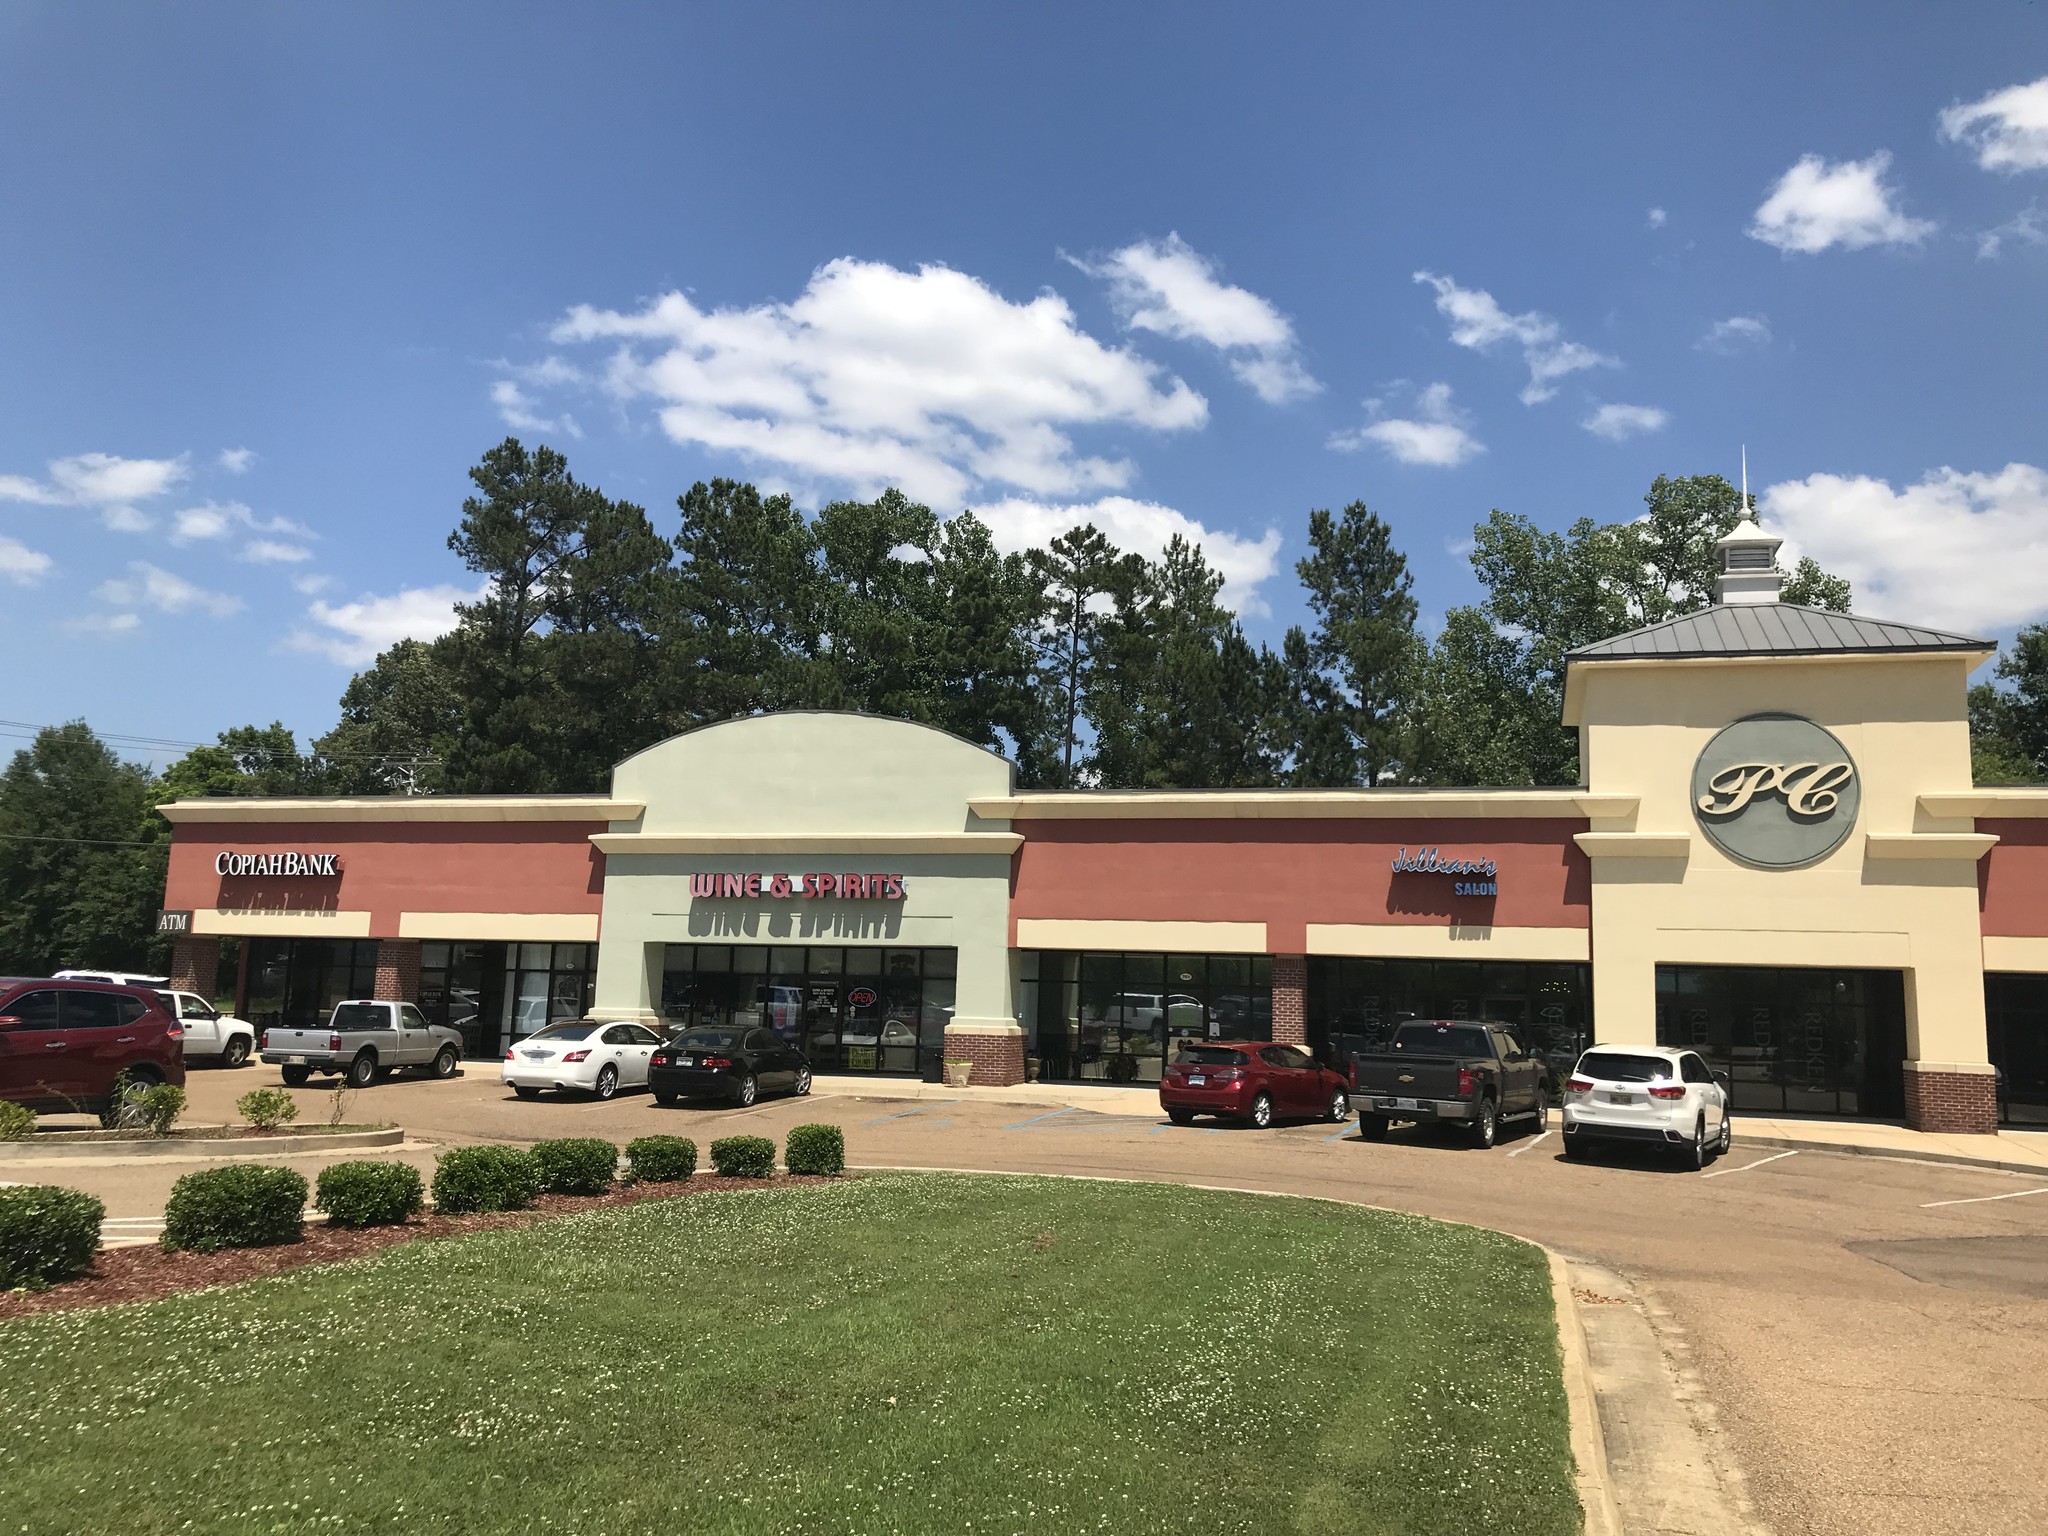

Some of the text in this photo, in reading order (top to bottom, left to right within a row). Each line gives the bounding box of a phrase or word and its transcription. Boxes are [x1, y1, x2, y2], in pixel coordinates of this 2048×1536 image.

[1391, 847, 1498, 877] Jillian's
[689, 873, 903, 900] WINE & SPIRITS
[1455, 882, 1497, 896] SALON
[158, 914, 188, 930] ATM
[849, 992, 874, 1003] OPEN
